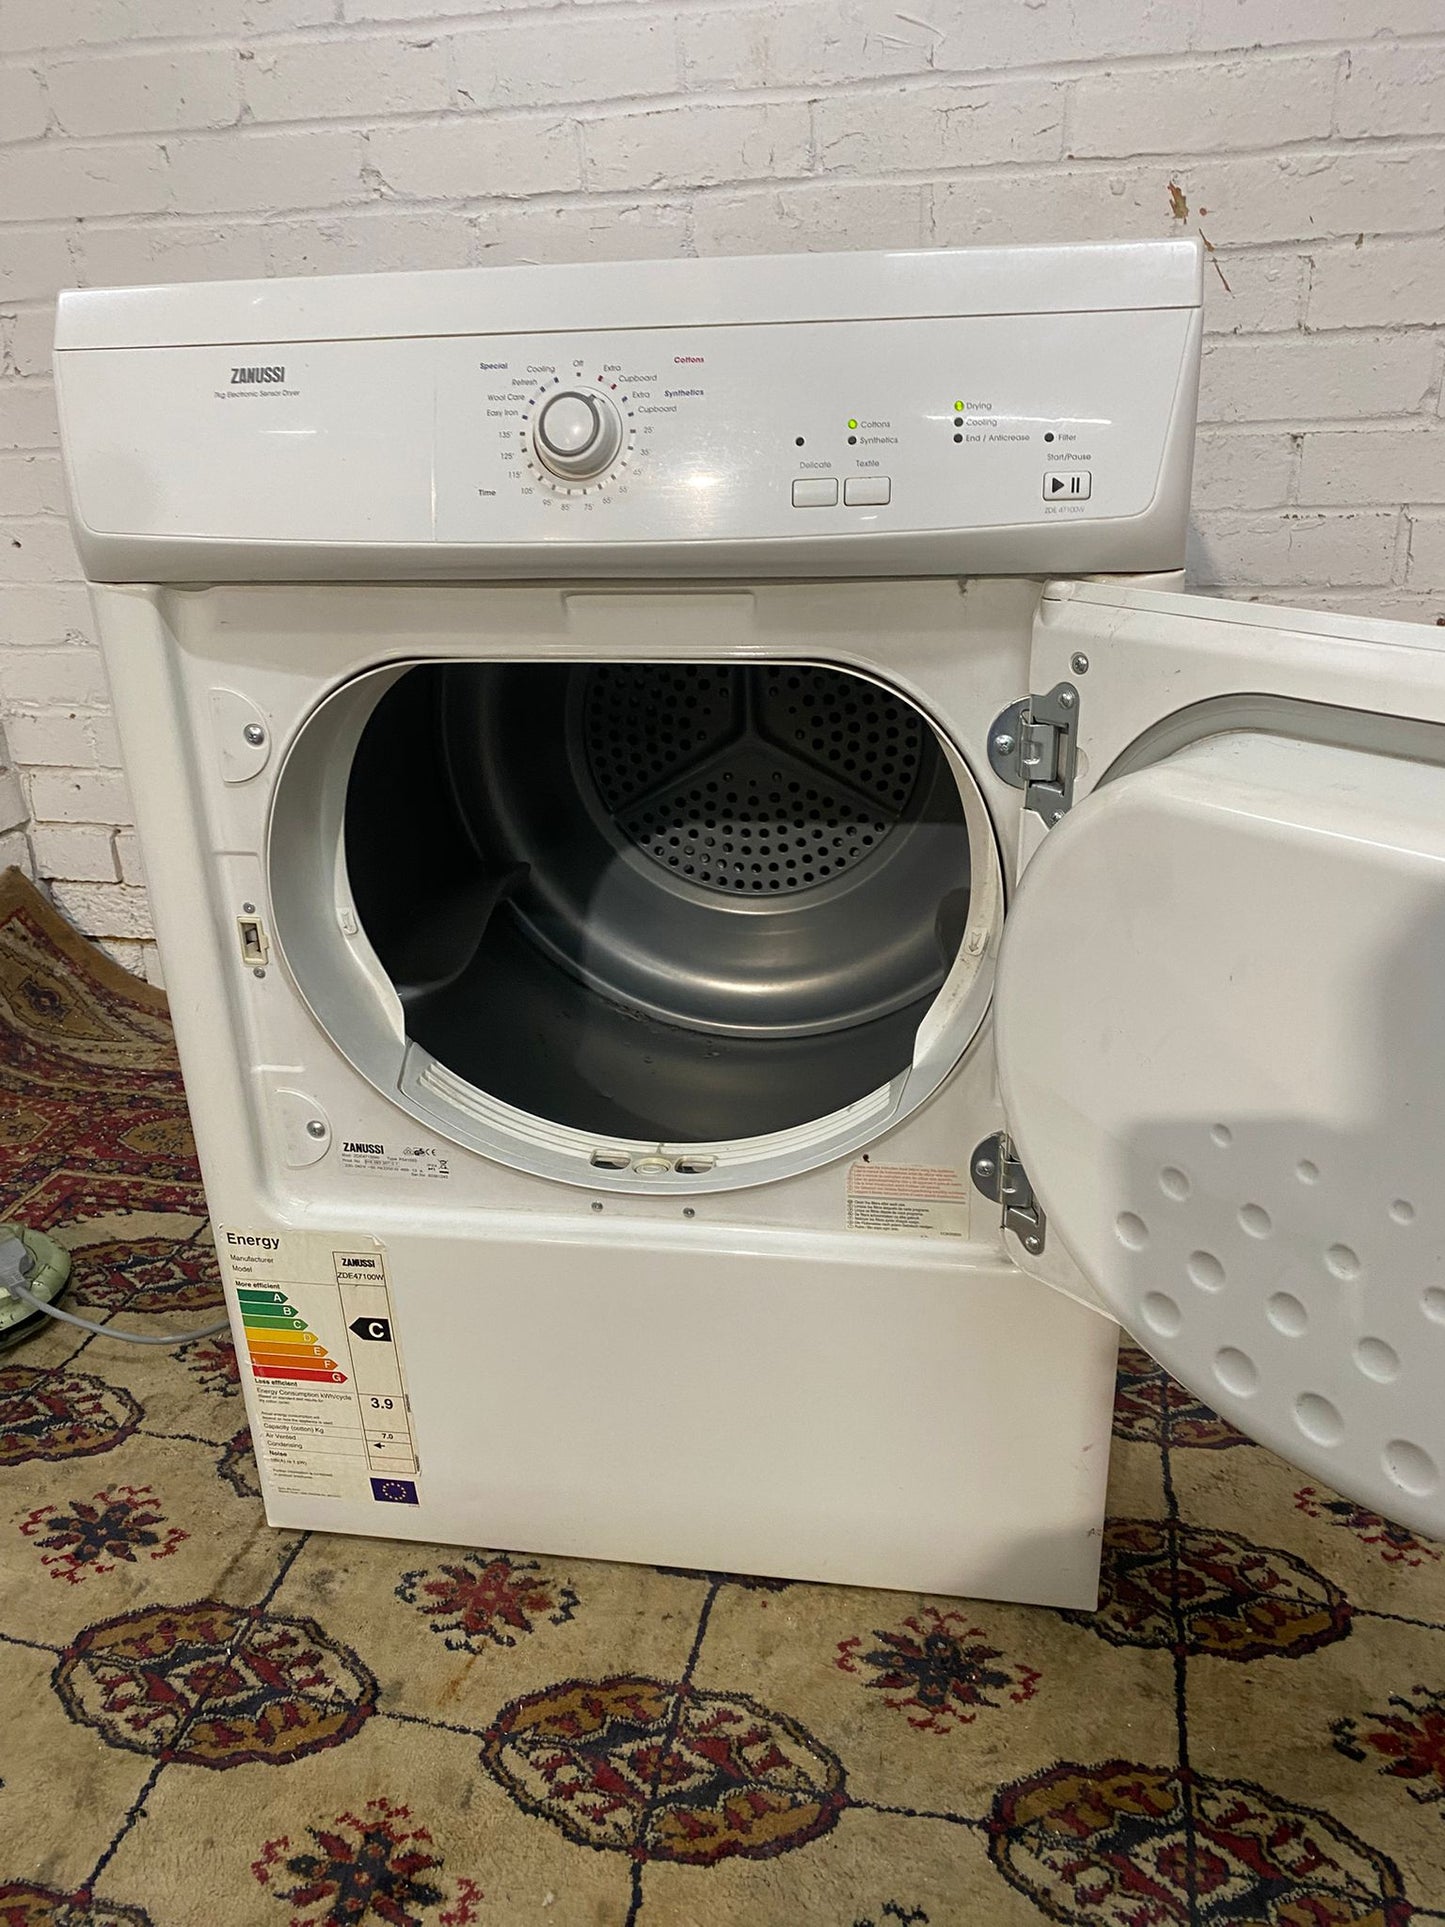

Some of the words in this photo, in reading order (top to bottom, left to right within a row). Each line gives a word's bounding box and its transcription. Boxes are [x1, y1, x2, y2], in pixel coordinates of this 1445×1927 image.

[527, 366, 555, 374] Cooling
[231, 366, 285, 384] ZANUSSI
[619, 374, 657, 383] Cupboard
[664, 389, 704, 397] Synthetics
[966, 402, 992, 411] Drying
[966, 419, 997, 427] Cooling
[860, 436, 898, 445] Synthetics
[343, 1142, 384, 1154] ZANUSSI
[226, 1232, 280, 1250] Energy
[230, 1254, 274, 1264] Manufacturer
[342, 1258, 375, 1268] ZANUSSI
[337, 1272, 384, 1281] ZDE47100W
[274, 1294, 282, 1302] A
[293, 1320, 301, 1328] C
[368, 1322, 384, 1338] C
[304, 1333, 311, 1342] D
[314, 1347, 321, 1355] E
[324, 1360, 331, 1369] F
[332, 1373, 341, 1382] G
[279, 1390, 319, 1398] Consumption
[370, 1397, 393, 1410] 3.9
[267, 1441, 302, 1449] Condensing
